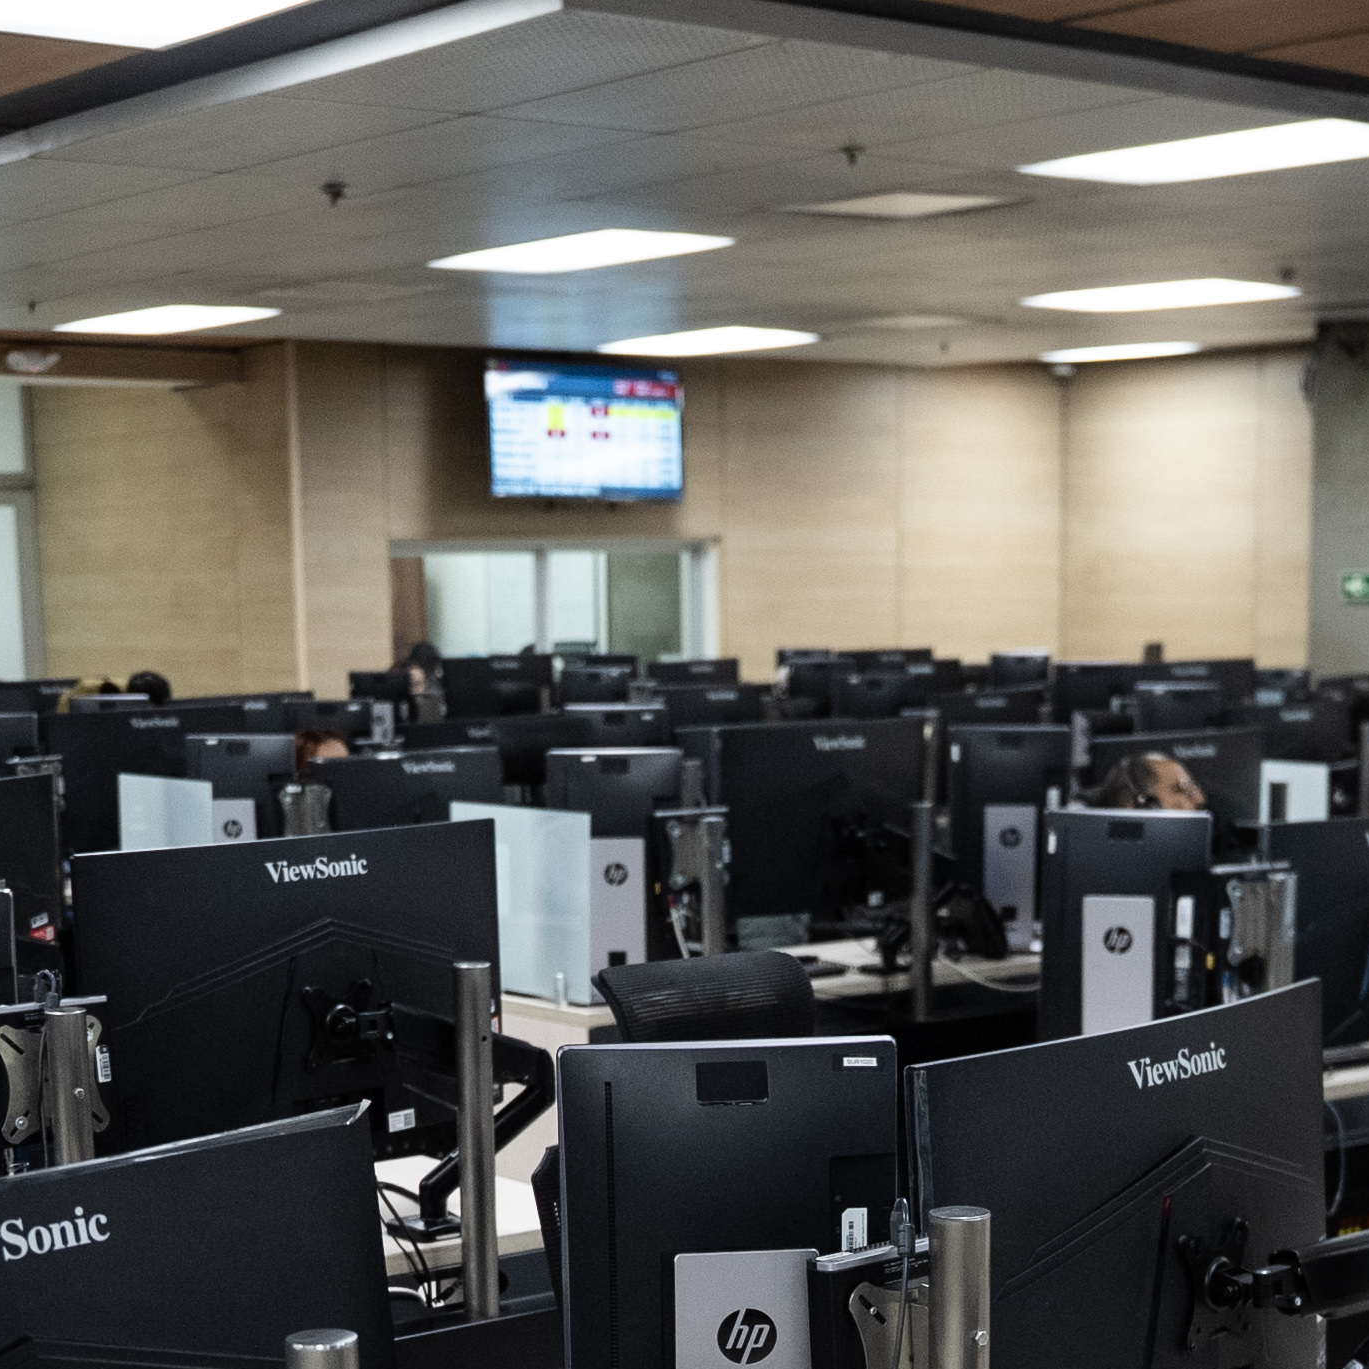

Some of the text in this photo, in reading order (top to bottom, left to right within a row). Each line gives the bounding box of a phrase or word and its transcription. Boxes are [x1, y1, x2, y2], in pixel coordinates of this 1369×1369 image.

[265, 854, 369, 884] ViewSonic
[1106, 927, 1131, 953] hp
[1127, 1041, 1227, 1089] ViewSonic
[721, 1308, 773, 1364] hp
